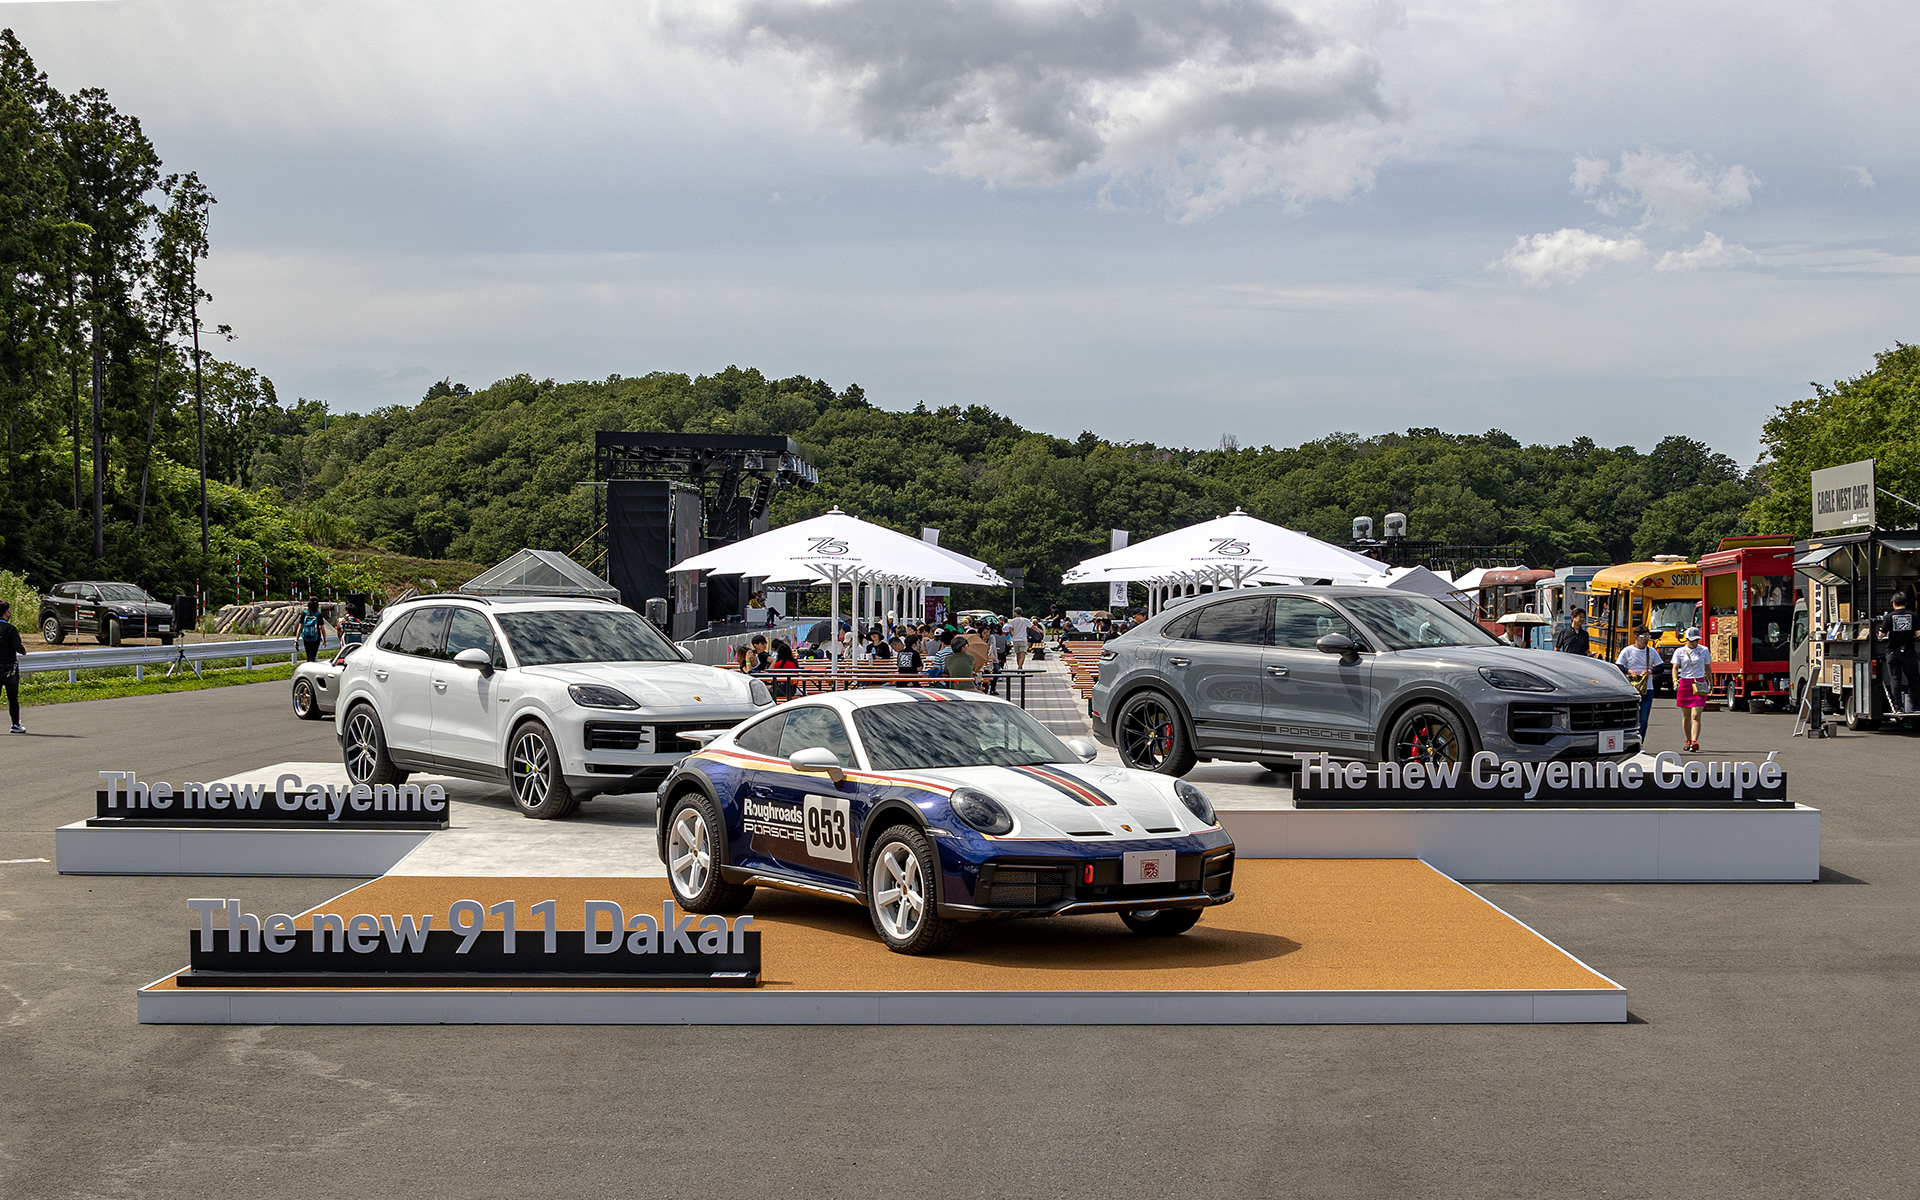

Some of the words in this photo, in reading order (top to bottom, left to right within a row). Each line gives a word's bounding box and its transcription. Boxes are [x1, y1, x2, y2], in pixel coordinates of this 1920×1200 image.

[1817, 490, 1835, 515] EAGLE
[1836, 487, 1852, 512] NEST
[1852, 483, 1869, 510] CAFE
[807, 537, 849, 555] 75
[1209, 538, 1250, 556] 75
[1671, 574, 1698, 586] SCHOOL
[1279, 726, 1351, 739] PORSCHE
[1292, 751, 1367, 790] The
[1378, 760, 1462, 790] new
[1470, 751, 1644, 799] Cayenne
[1653, 750, 1783, 799] Coupé
[99, 771, 174, 809] The
[183, 782, 266, 810] new
[275, 773, 446, 821] Cayenne
[743, 798, 803, 824] Roughroads
[743, 822, 805, 842] PORSCHE
[808, 806, 847, 851] 953
[187, 898, 297, 954] The
[312, 913, 434, 954] new
[448, 899, 557, 954] 911
[584, 899, 754, 955] Dakar
